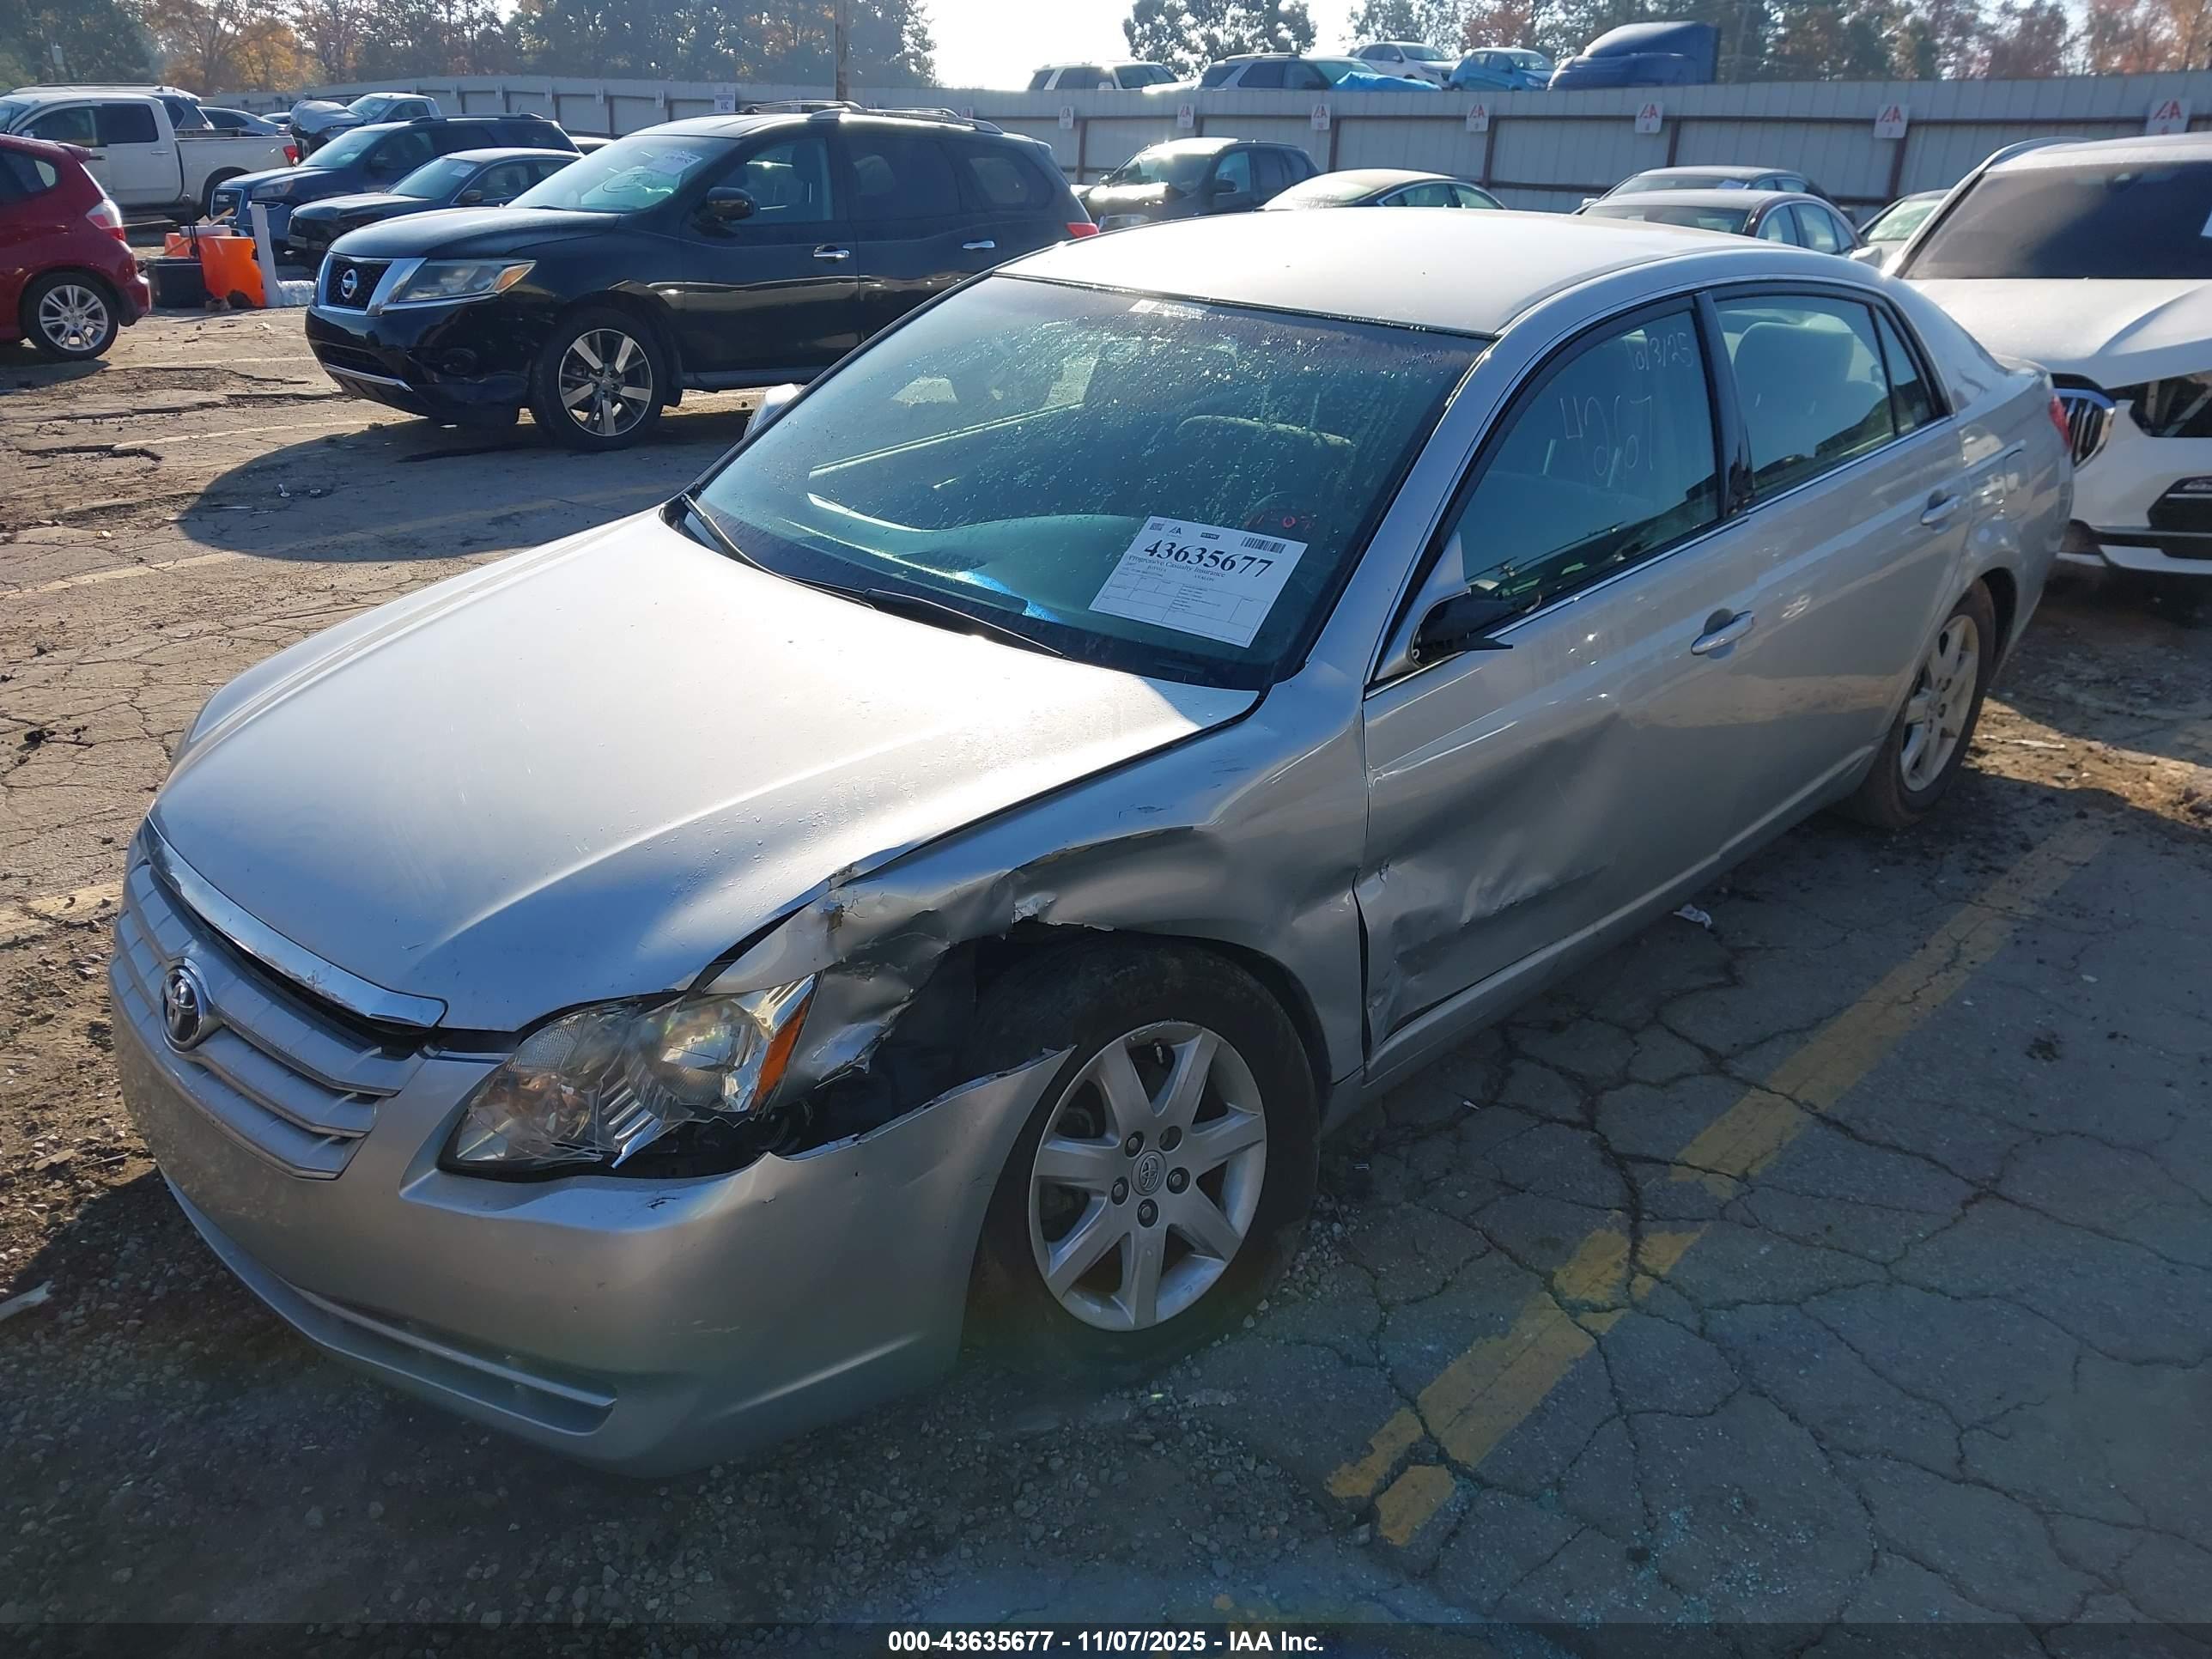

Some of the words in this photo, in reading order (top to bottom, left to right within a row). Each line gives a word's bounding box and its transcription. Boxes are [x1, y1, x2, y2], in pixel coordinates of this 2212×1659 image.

[1128, 555, 1165, 568] Progressive
[1164, 561, 1193, 573] Casualty
[1194, 566, 1226, 579] Insurance
[1143, 538, 1274, 578] 43635677
